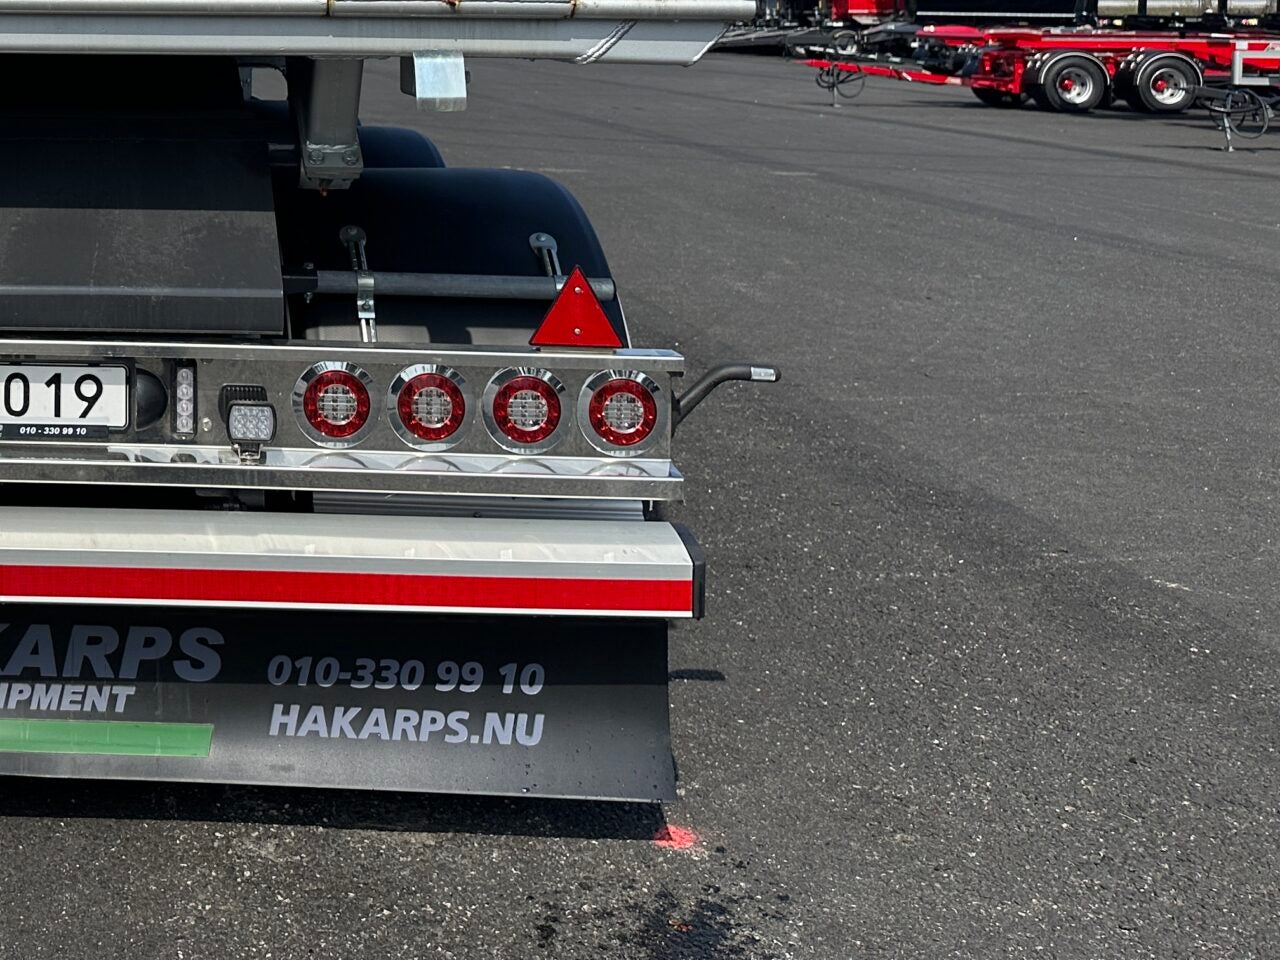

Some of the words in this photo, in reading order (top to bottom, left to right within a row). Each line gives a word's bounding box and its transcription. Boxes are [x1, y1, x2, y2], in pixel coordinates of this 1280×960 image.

[3, 372, 104, 418] 019
[20, 427, 36, 435] 010
[44, 427, 60, 435] 330
[62, 427, 73, 435] 99
[267, 655, 425, 691] 010-330
[434, 660, 484, 692] 99
[498, 662, 545, 695] 10
[269, 703, 546, 746] HAKARPS.NU
